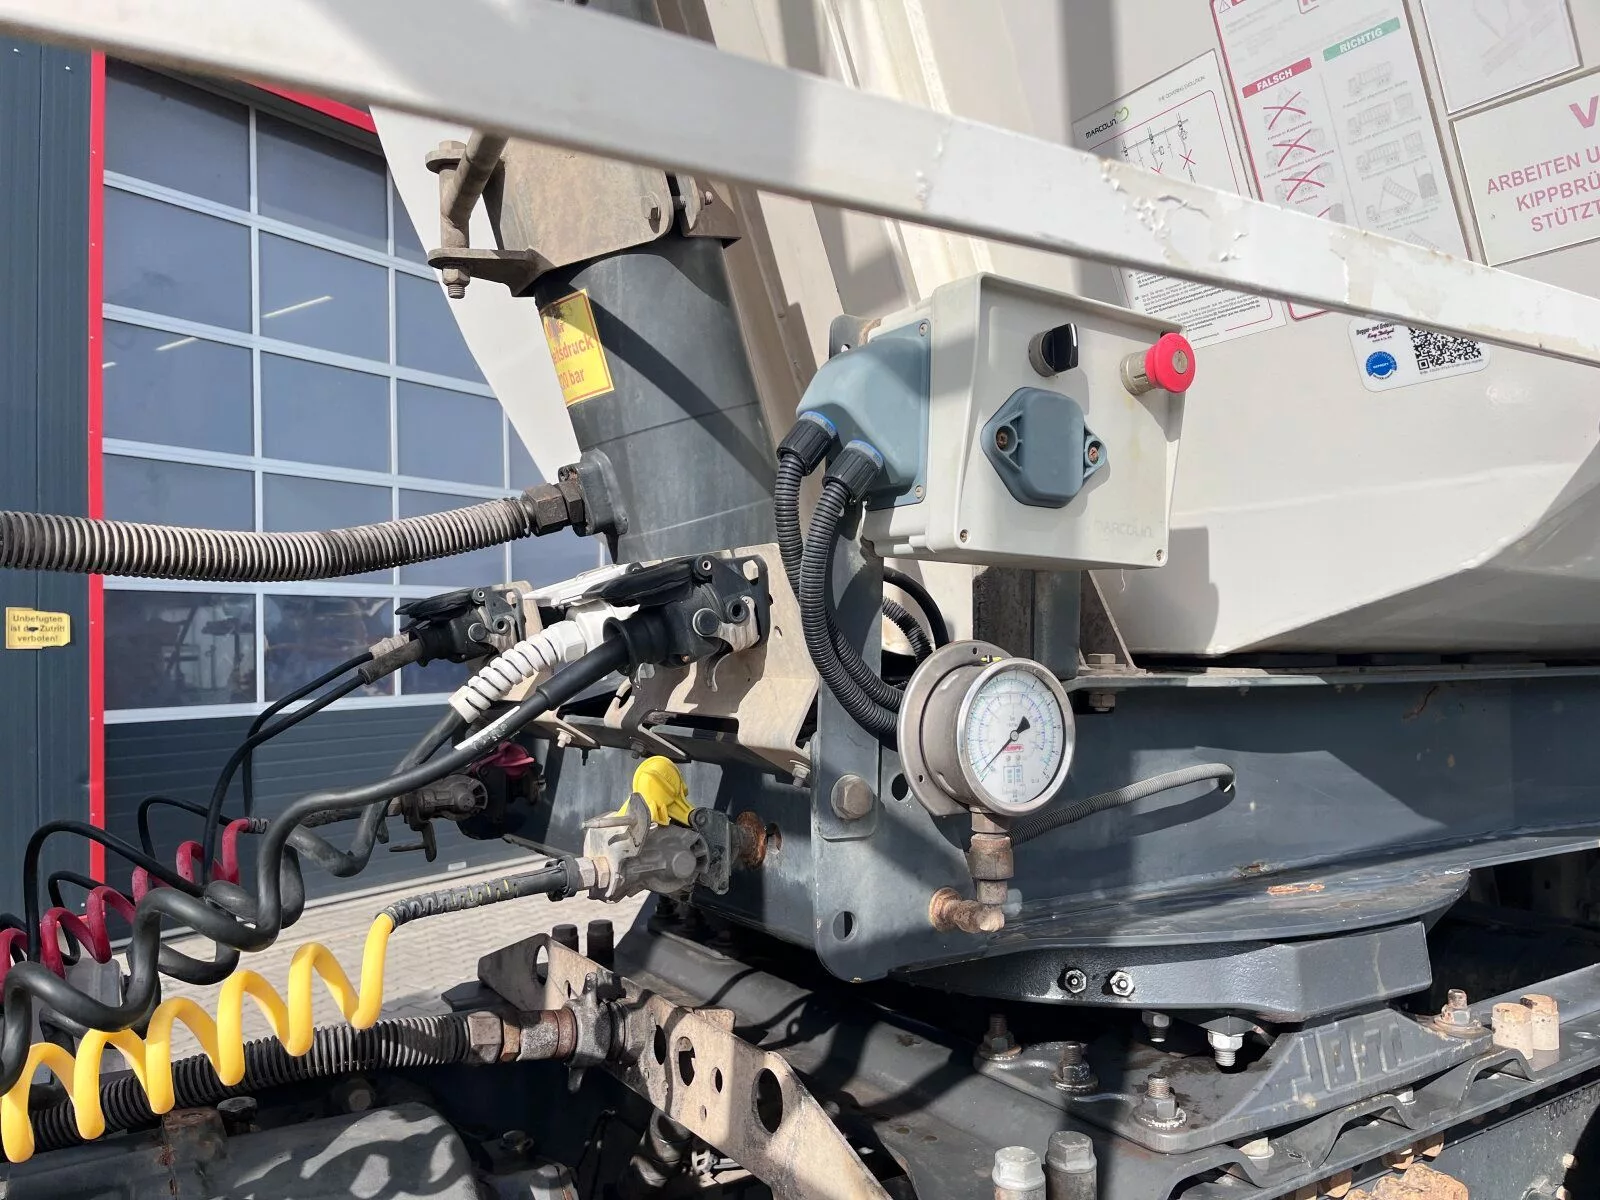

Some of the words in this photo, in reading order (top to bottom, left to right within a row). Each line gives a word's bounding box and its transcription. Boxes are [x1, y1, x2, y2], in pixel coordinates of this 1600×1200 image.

[1338, 27, 1383, 54] RICHTIG
[1256, 68, 1293, 92] FALSCH
[1487, 152, 1581, 195] ARBEITEN
[568, 369, 585, 384] bar
[13, 614, 63, 623] Unbefugten
[17, 634, 58, 642] verboten!
